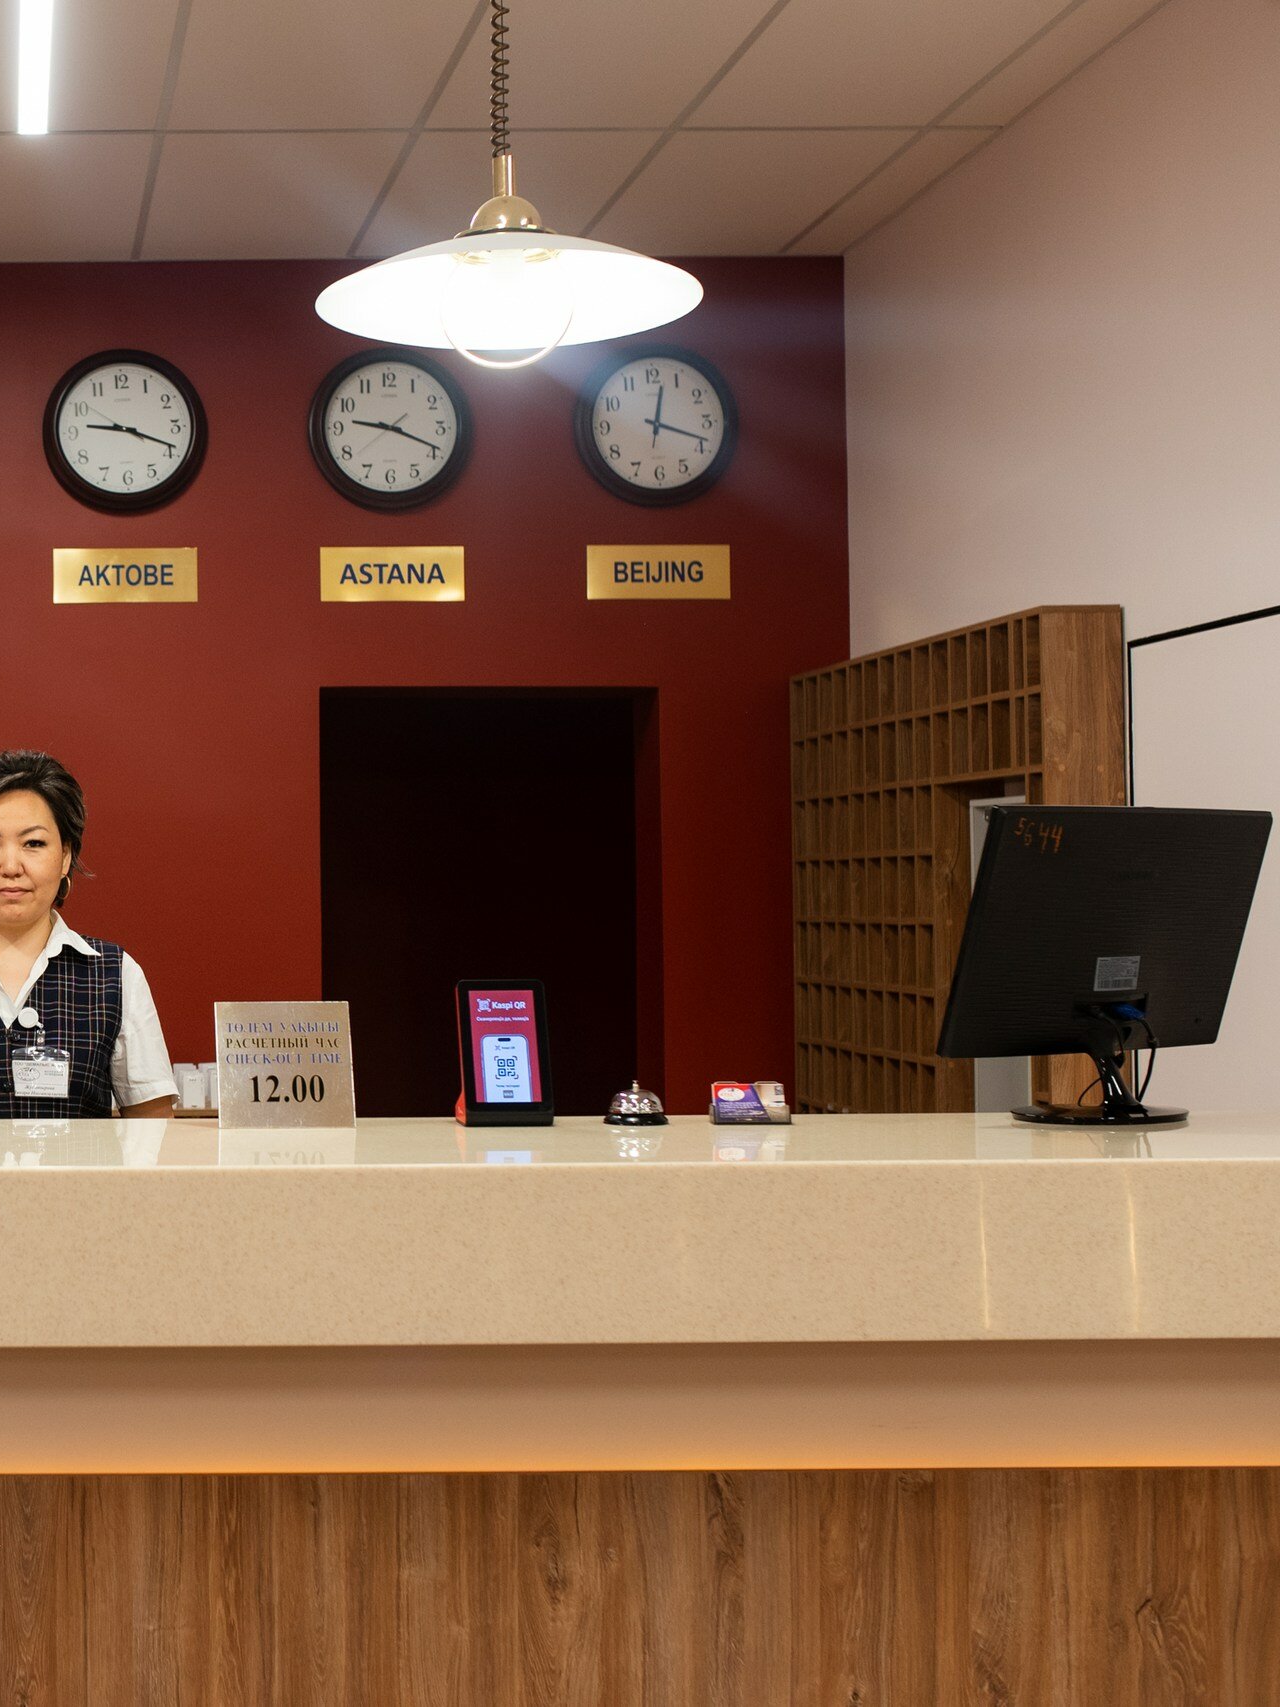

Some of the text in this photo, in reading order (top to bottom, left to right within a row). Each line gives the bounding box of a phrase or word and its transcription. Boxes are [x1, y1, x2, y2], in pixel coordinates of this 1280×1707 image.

[114, 374, 130, 389] 12
[382, 372, 397, 387] 12
[624, 376, 635, 391] 11
[646, 368, 661, 384] 12
[92, 382, 103, 397] 11
[359, 379, 370, 394] 11
[160, 394, 172, 409] 2
[427, 395, 438, 410] 2
[606, 396, 620, 412] 10
[692, 389, 703, 404] 2
[74, 401, 89, 417] 10
[341, 397, 355, 413] 10
[170, 419, 181, 434] 3
[333, 421, 344, 436] 9
[435, 420, 446, 436] 3
[599, 420, 610, 436] 9
[701, 414, 712, 429] 3
[68, 425, 79, 441] 9
[78, 449, 89, 465] 8
[341, 445, 353, 461] 8
[609, 444, 621, 460] 8
[99, 466, 110, 482] 7
[147, 464, 157, 479] 5
[362, 464, 373, 479] 7
[409, 464, 420, 479] 5
[630, 461, 641, 477] 7
[654, 465, 665, 481] 6
[678, 459, 689, 474] 5
[122, 470, 134, 486] 6
[385, 469, 396, 484] 6
[78, 564, 174, 587] AKTOBE
[339, 563, 446, 585] ASTANA
[614, 560, 705, 584] BEIJING
[514, 1001, 526, 1009] QR
[226, 1036, 342, 1049] РАСЧЕТНЫЙ ЧАС
[250, 1074, 325, 1103] 12.00
